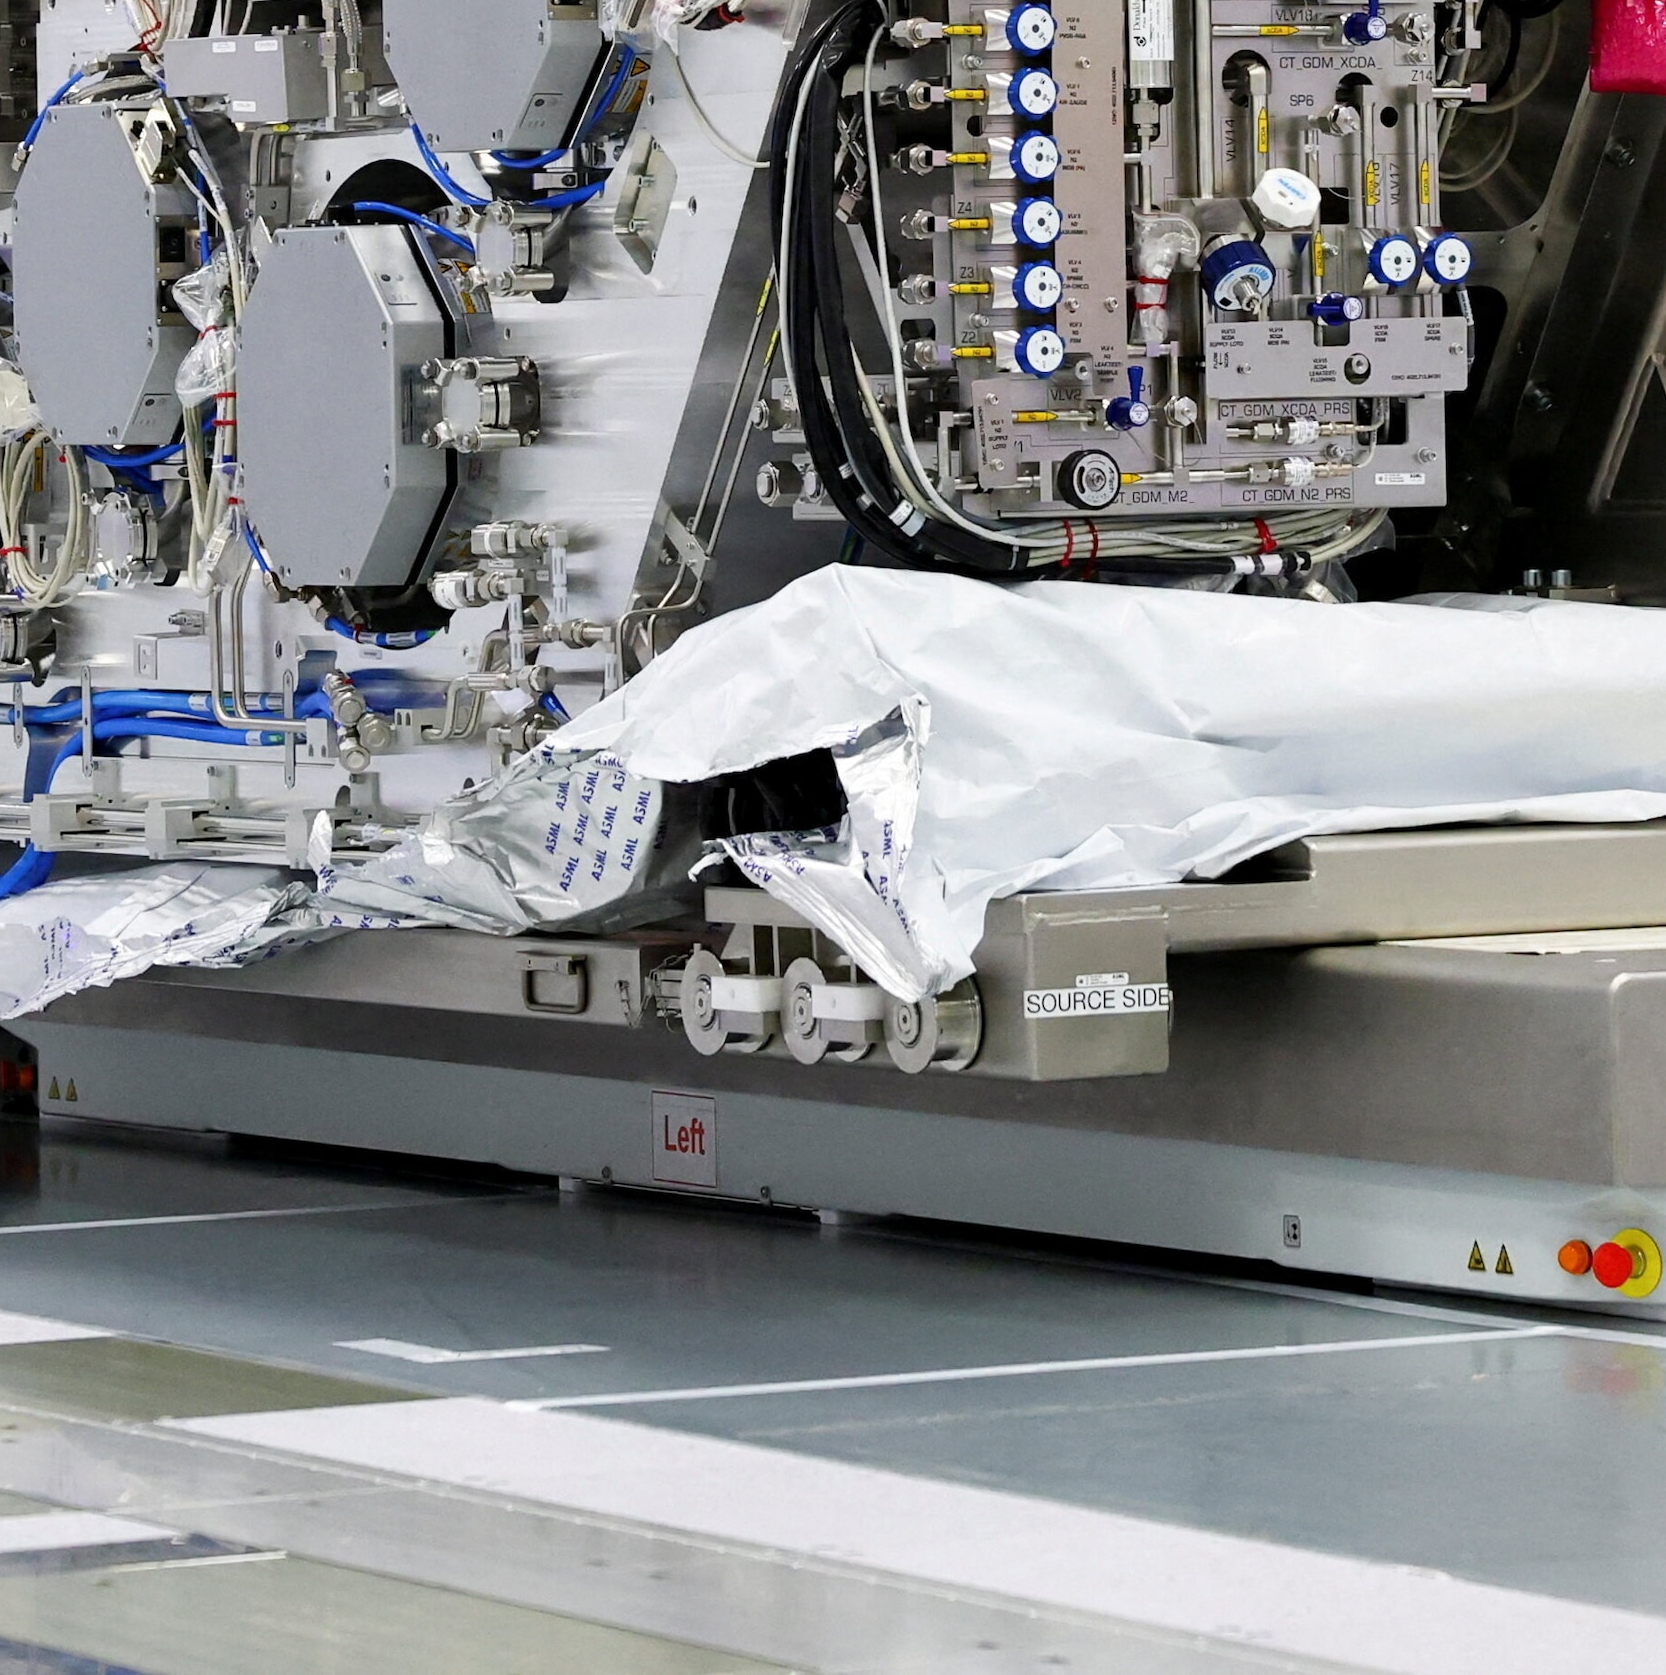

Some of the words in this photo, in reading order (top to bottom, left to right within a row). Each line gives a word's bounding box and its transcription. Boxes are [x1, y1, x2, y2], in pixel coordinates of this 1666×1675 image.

[1275, 9, 1313, 21] VLV18
[1279, 56, 1383, 71] CT_GDM_XCDA_
[1411, 69, 1434, 82] Z14
[1289, 94, 1315, 107] SP6
[1390, 162, 1401, 205] VLV17
[958, 201, 972, 214] Z4
[960, 266, 975, 278] Z3
[961, 331, 976, 344] Z2
[1051, 388, 1082, 401] VLV2
[1221, 403, 1351, 418] CT_GDM_XCDA_PRS
[1242, 486, 1351, 503] CT_GDM_N2_PRS
[556, 780, 571, 812] ASML
[581, 770, 600, 805] ASML
[601, 804, 618, 839] ASML
[632, 790, 652, 825] ASML
[544, 821, 561, 855] ASML
[572, 813, 589, 846] ASML
[883, 819, 894, 860] ASML
[591, 849, 607, 882] ASML
[620, 837, 639, 871] ASML
[559, 856, 580, 892] ASML
[1026, 990, 1116, 1014] SOURCE
[1122, 987, 1170, 1008] SIDE
[664, 1114, 706, 1156] Left
